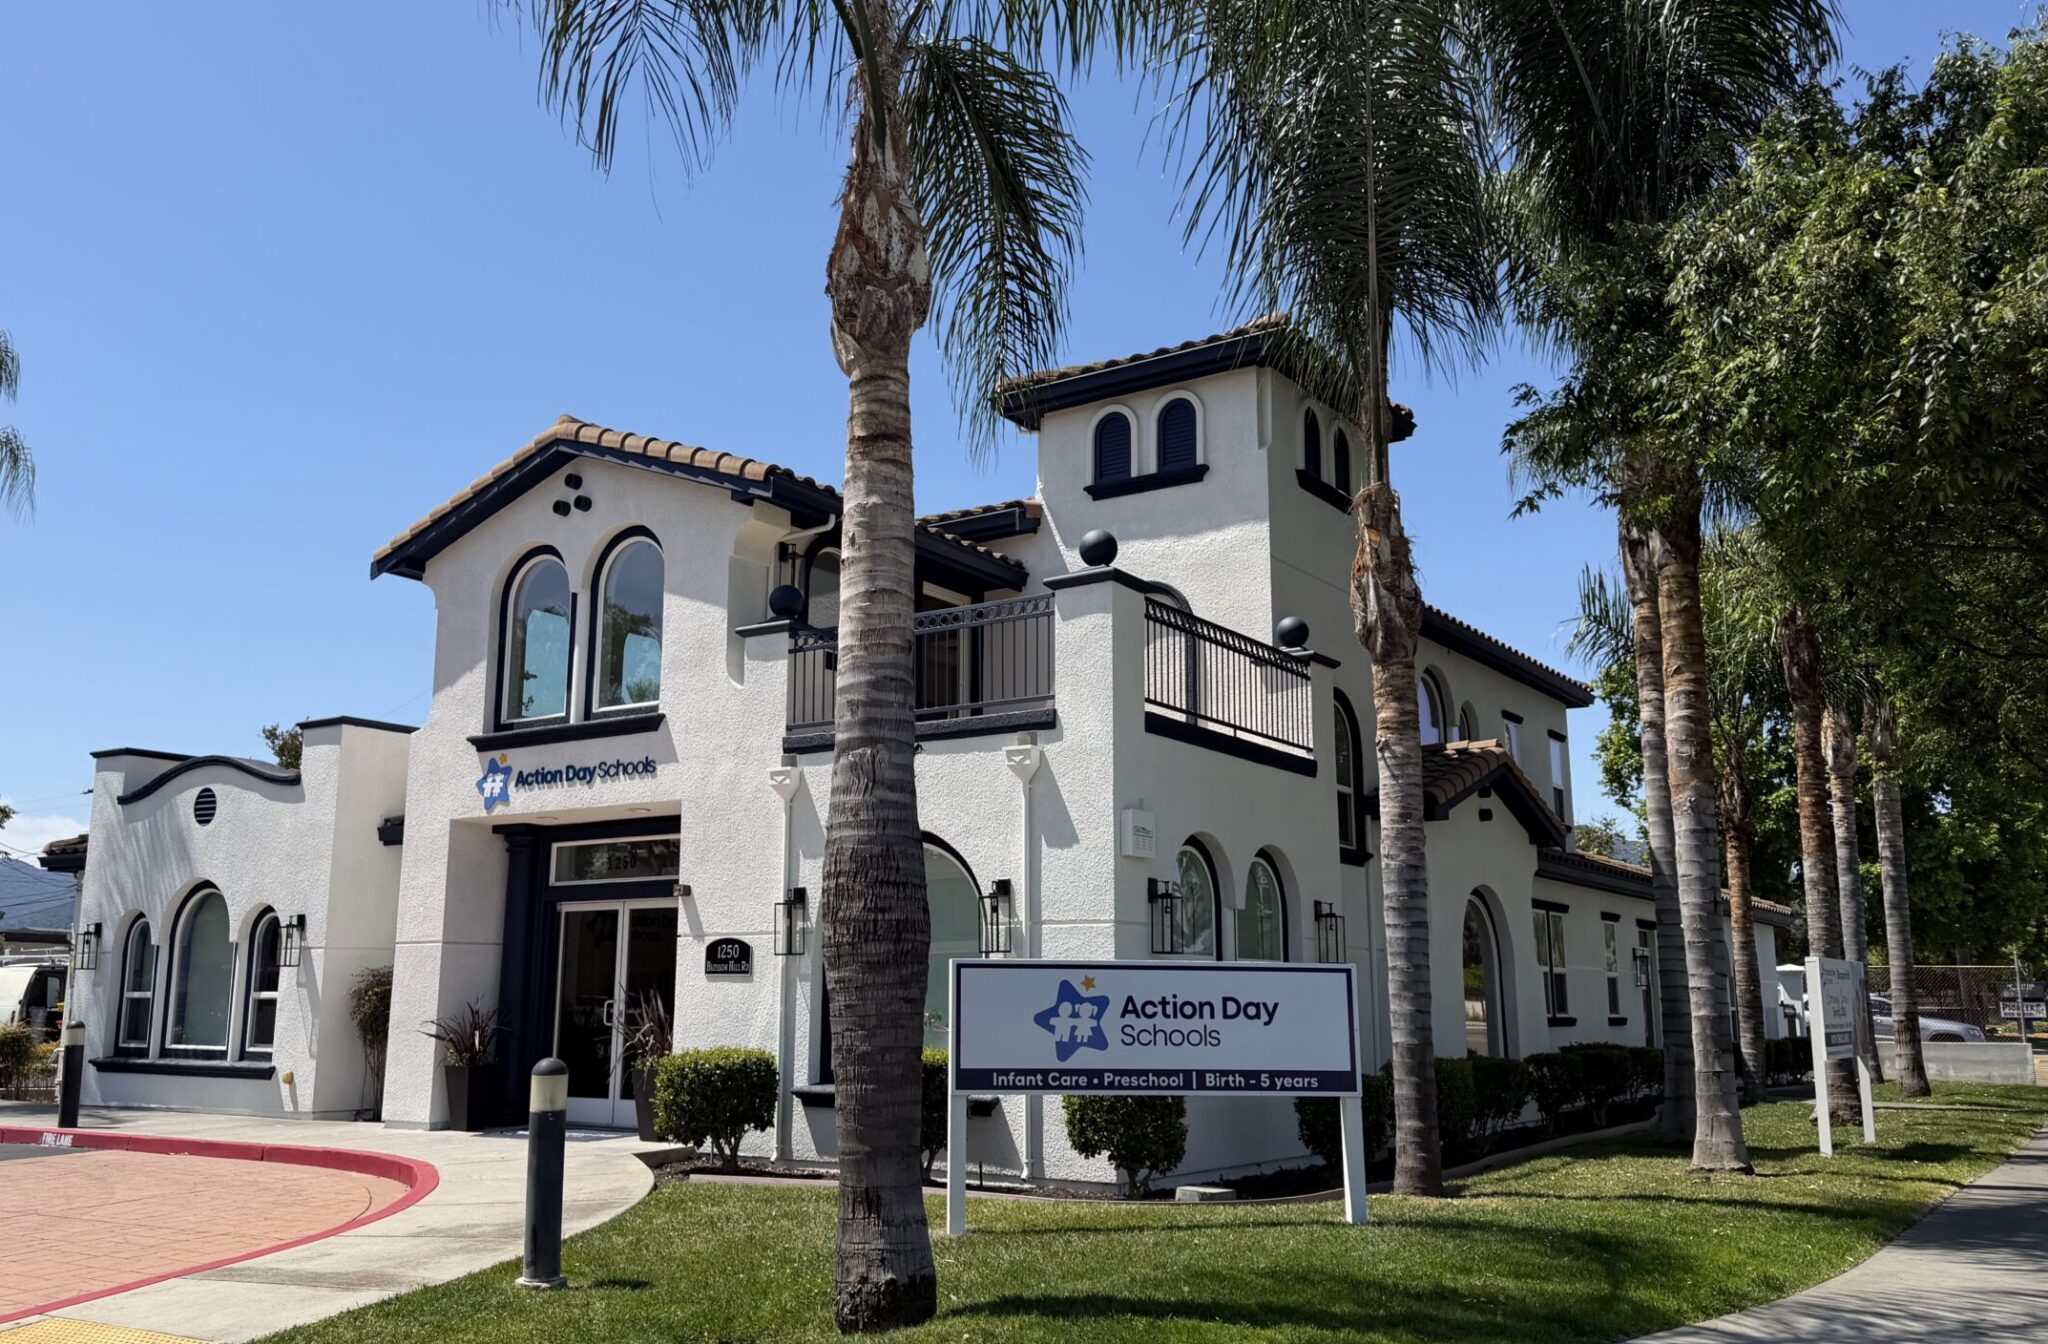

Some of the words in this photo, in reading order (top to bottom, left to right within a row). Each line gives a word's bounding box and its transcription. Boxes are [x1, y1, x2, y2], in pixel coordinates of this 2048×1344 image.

[514, 766, 563, 788] Action
[565, 765, 597, 784] Day
[597, 756, 656, 779] Schools
[607, 853, 637, 870] 1250
[717, 944, 740, 959] 1250
[1120, 994, 1215, 1020] Action
[1221, 996, 1280, 1027] Day
[1120, 1024, 1222, 1047] Schools
[992, 1072, 1043, 1086] Infant
[1048, 1072, 1088, 1087] Care
[1103, 1072, 1184, 1087] Preschool
[1205, 1073, 1245, 1087] Birth
[1260, 1073, 1270, 1087] 5
[1274, 1076, 1319, 1090] years
[41, 1132, 57, 1146] FIRE
[56, 1133, 74, 1147] LANE
